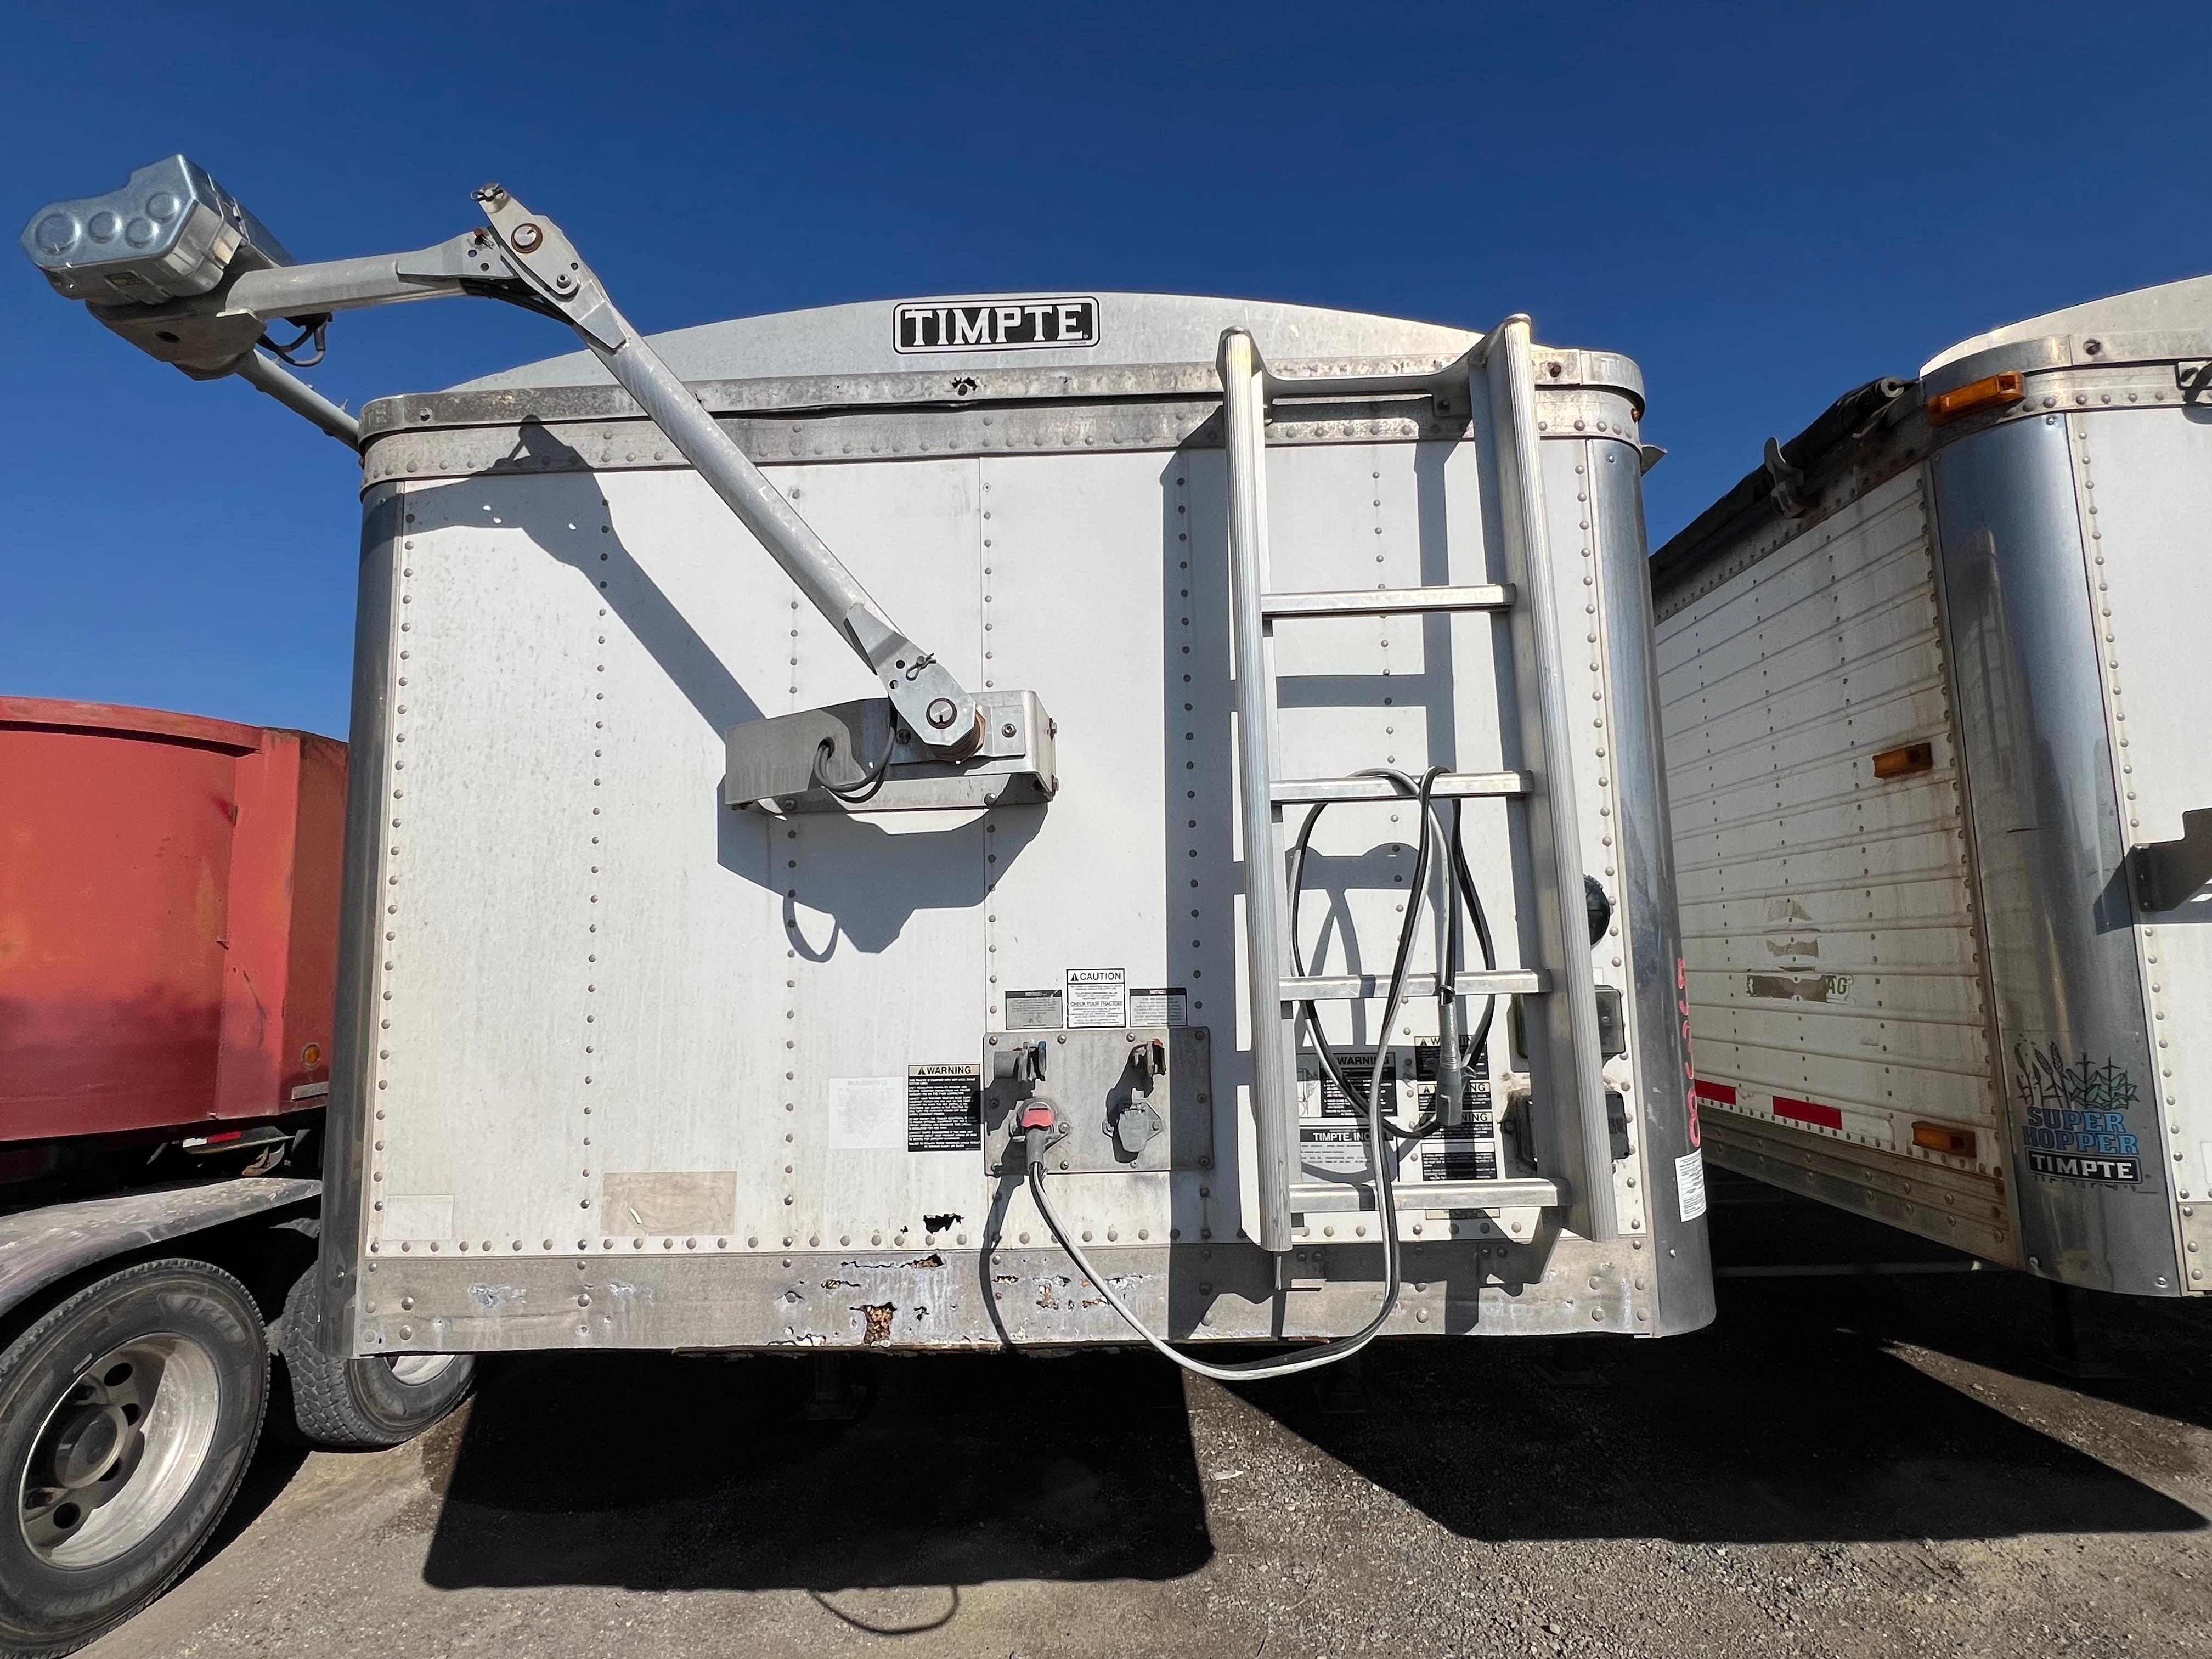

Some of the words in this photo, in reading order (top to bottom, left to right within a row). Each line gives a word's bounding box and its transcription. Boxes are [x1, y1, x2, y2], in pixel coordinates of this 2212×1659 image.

[905, 304, 1083, 346] TIMPTE
[1080, 972, 1121, 981] CAUTION
[927, 1066, 972, 1074] WARNING
[2027, 1106, 2126, 1133] SUPER
[2022, 1126, 2139, 1154] HOPPER
[2032, 1154, 2133, 1178] TIMPTE
